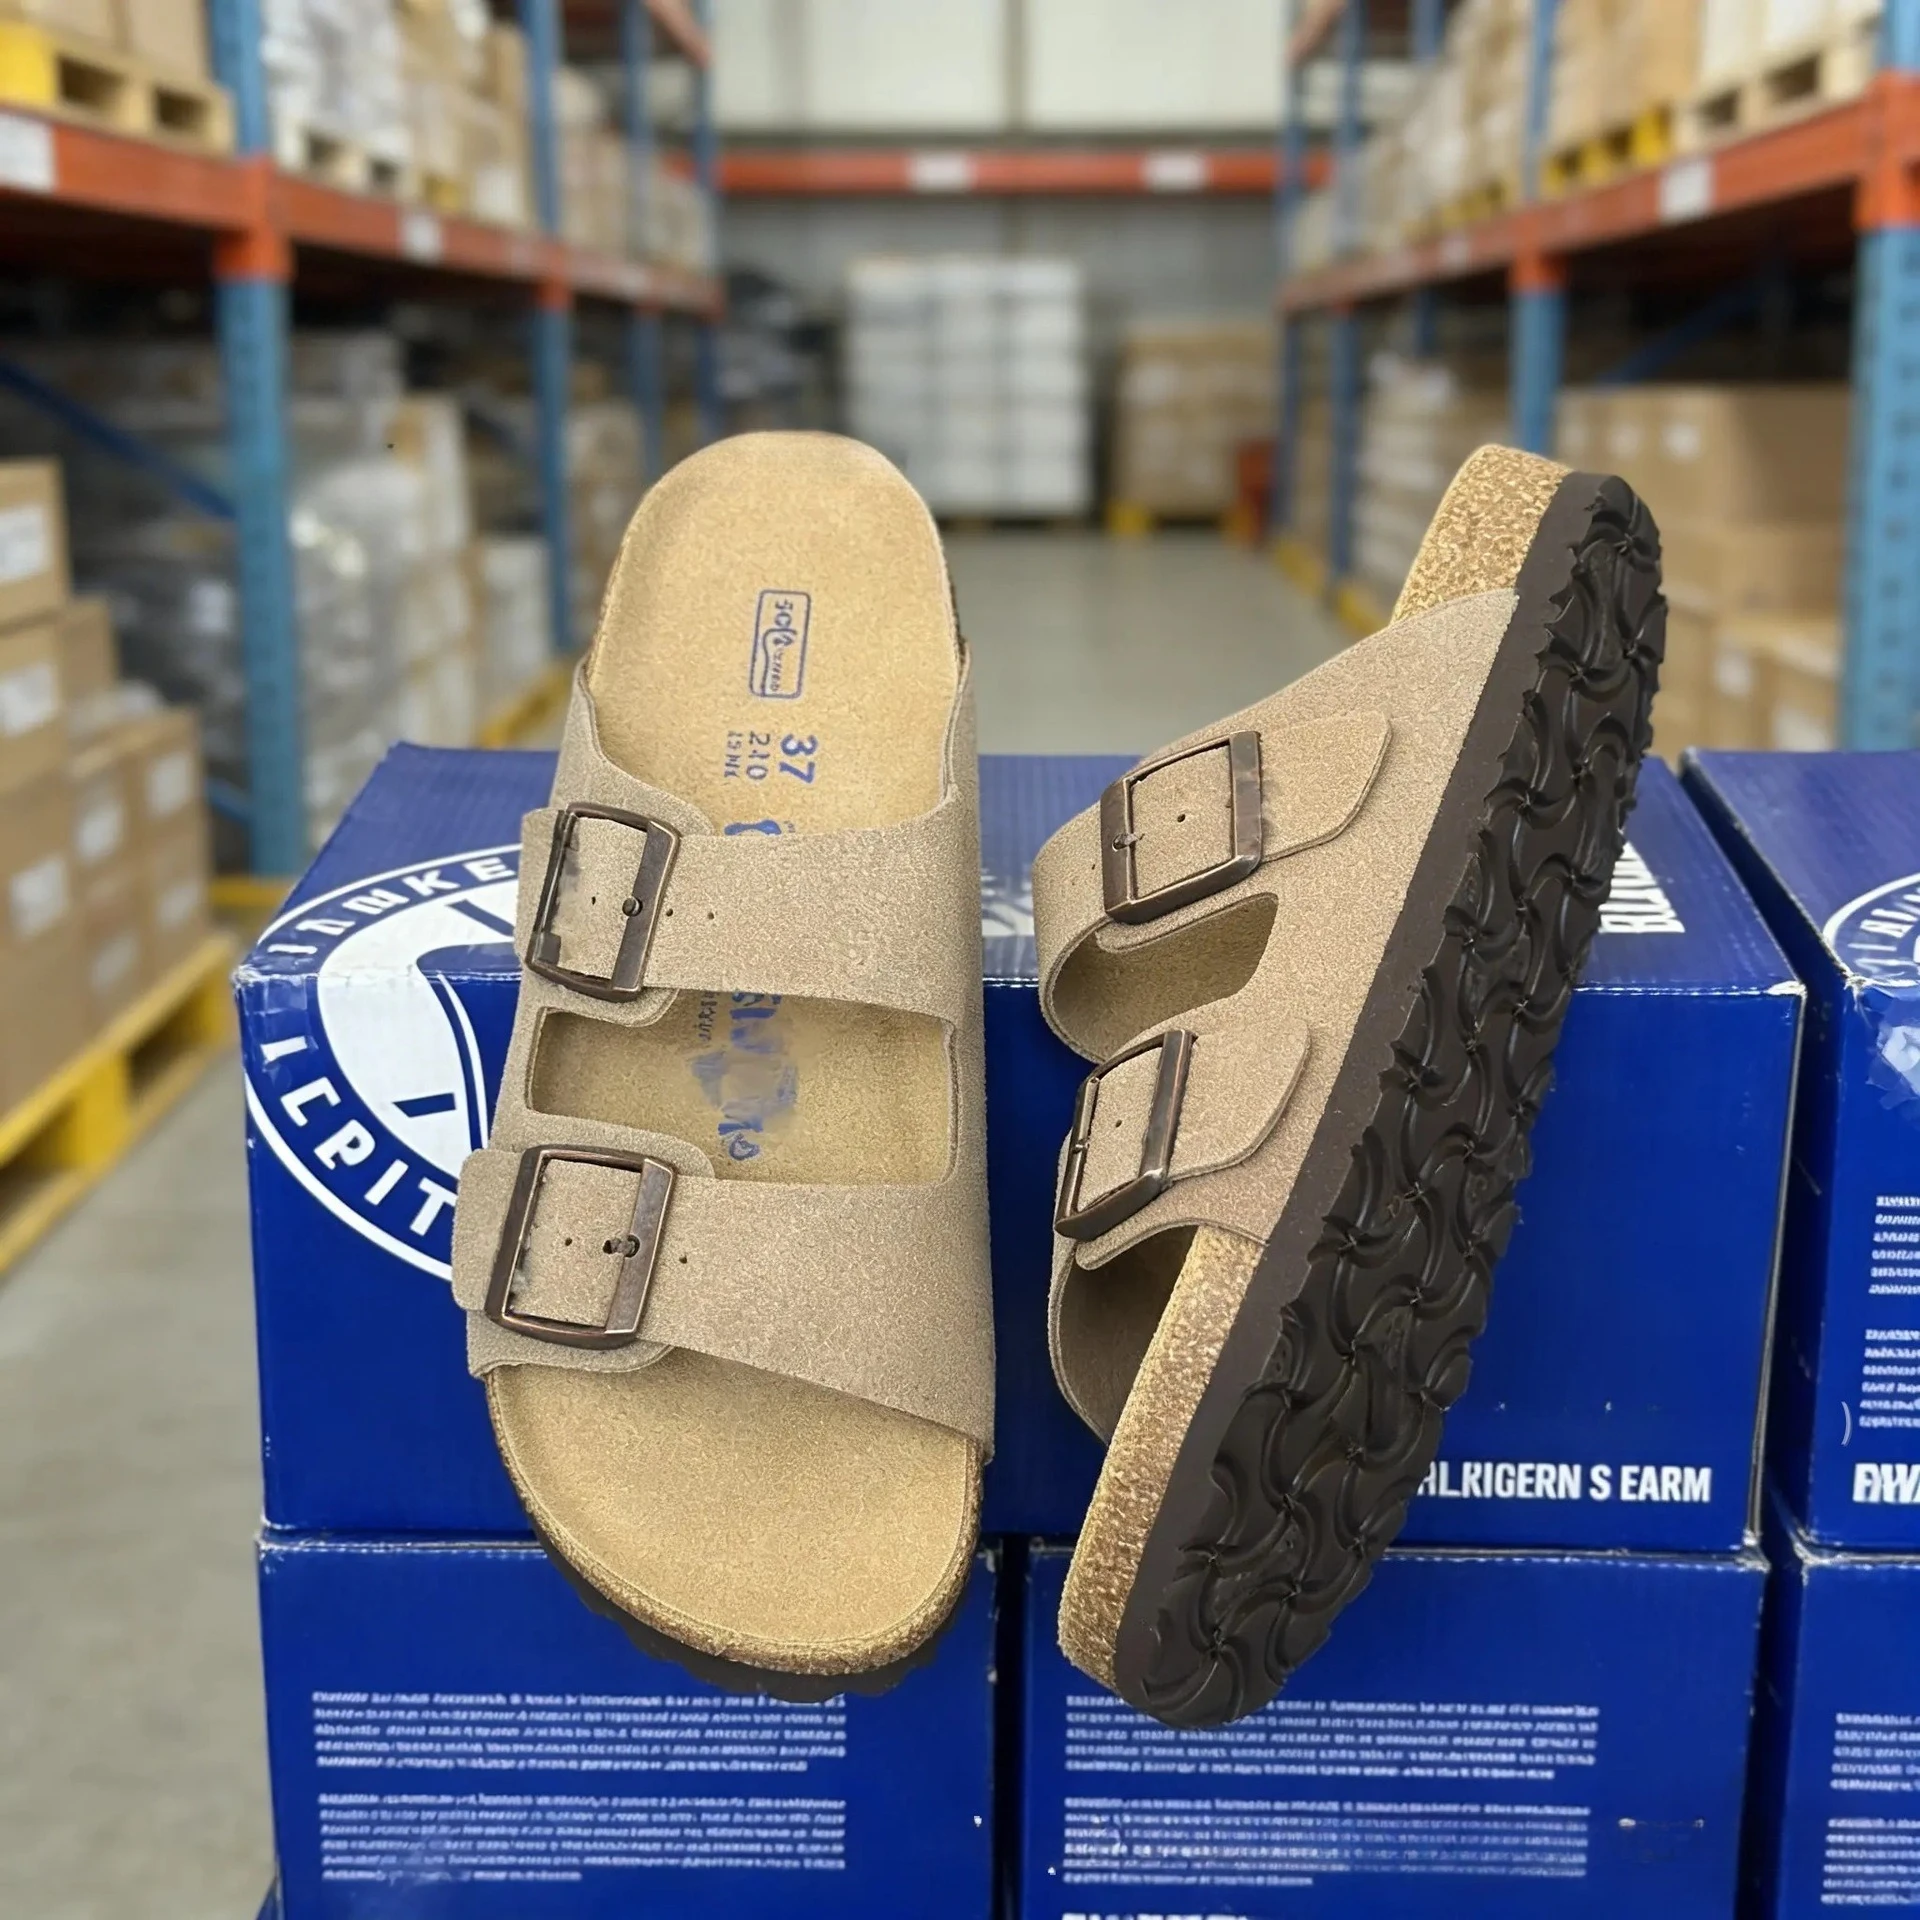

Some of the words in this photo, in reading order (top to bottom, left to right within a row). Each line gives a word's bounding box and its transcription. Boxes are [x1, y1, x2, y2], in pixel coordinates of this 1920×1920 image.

[778, 733, 819, 785] 37
[1589, 1463, 1612, 1502] S
[1620, 1464, 1712, 1504] EARM
